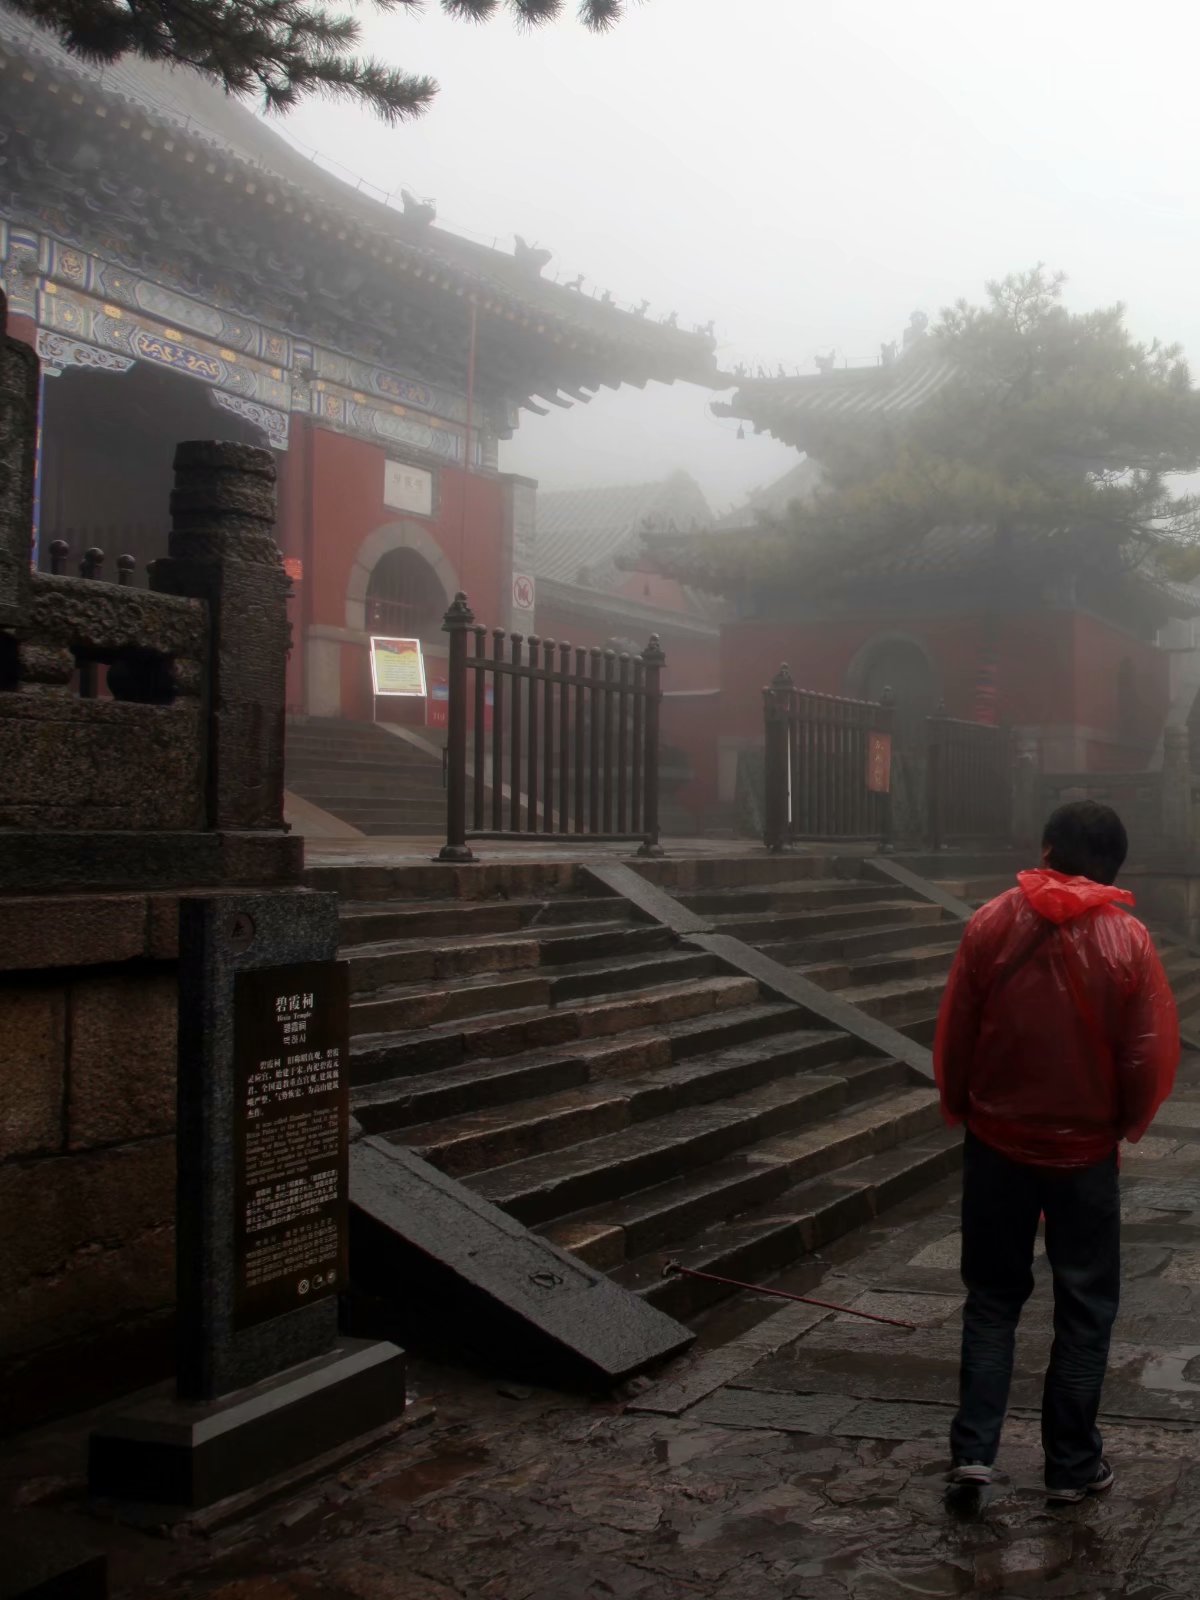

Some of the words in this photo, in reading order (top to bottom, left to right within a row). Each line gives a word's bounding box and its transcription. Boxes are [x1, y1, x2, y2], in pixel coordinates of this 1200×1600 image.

[276, 993, 314, 1012] 碧霞祠
[294, 1012, 312, 1020] Temple
